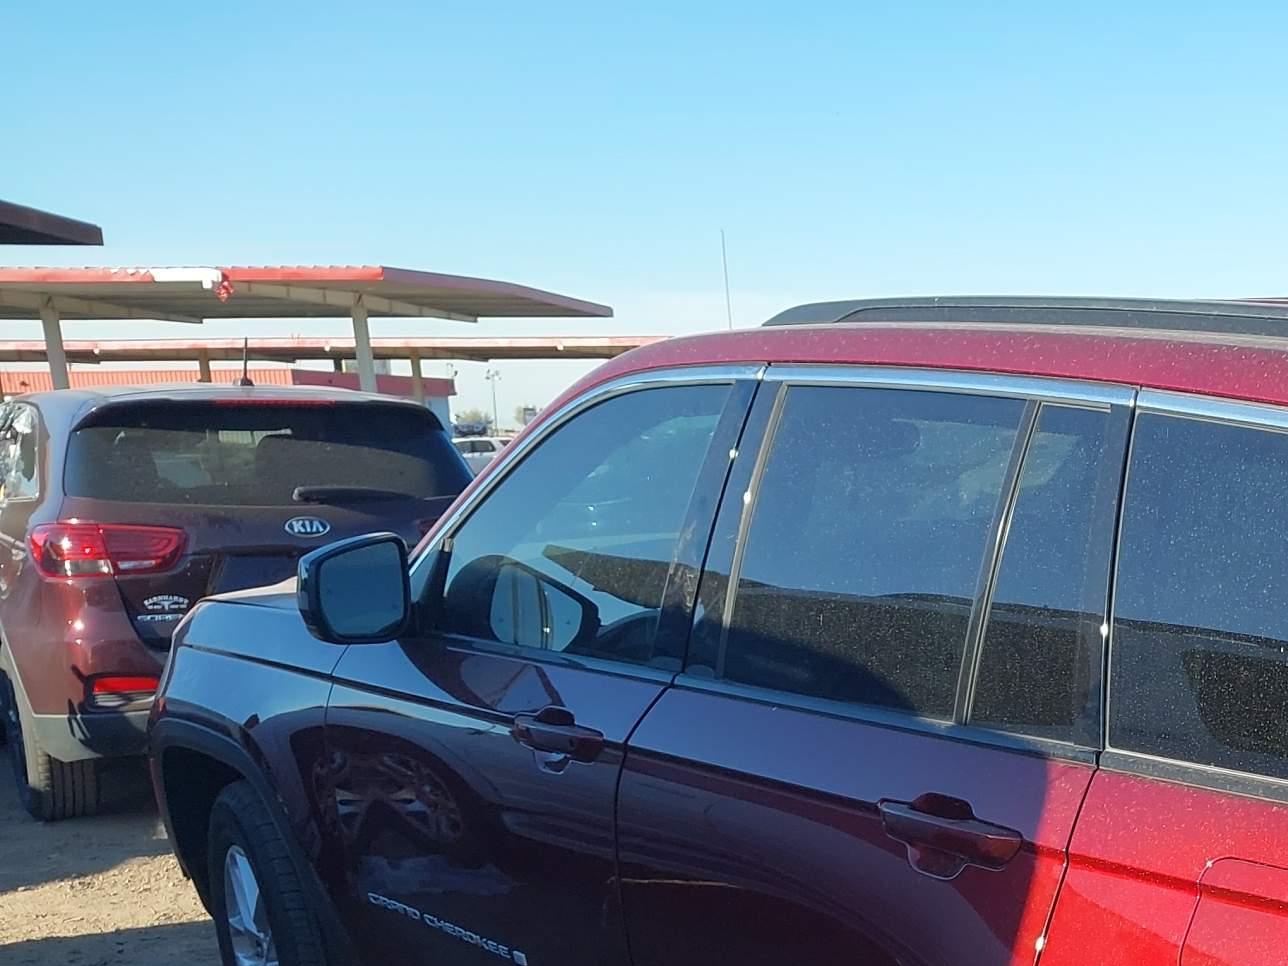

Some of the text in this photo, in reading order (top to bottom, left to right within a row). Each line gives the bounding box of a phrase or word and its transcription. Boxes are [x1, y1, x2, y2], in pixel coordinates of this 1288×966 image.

[292, 519, 325, 534] KIA
[367, 892, 421, 920] GRAND
[423, 913, 511, 960] CHEROKEE
